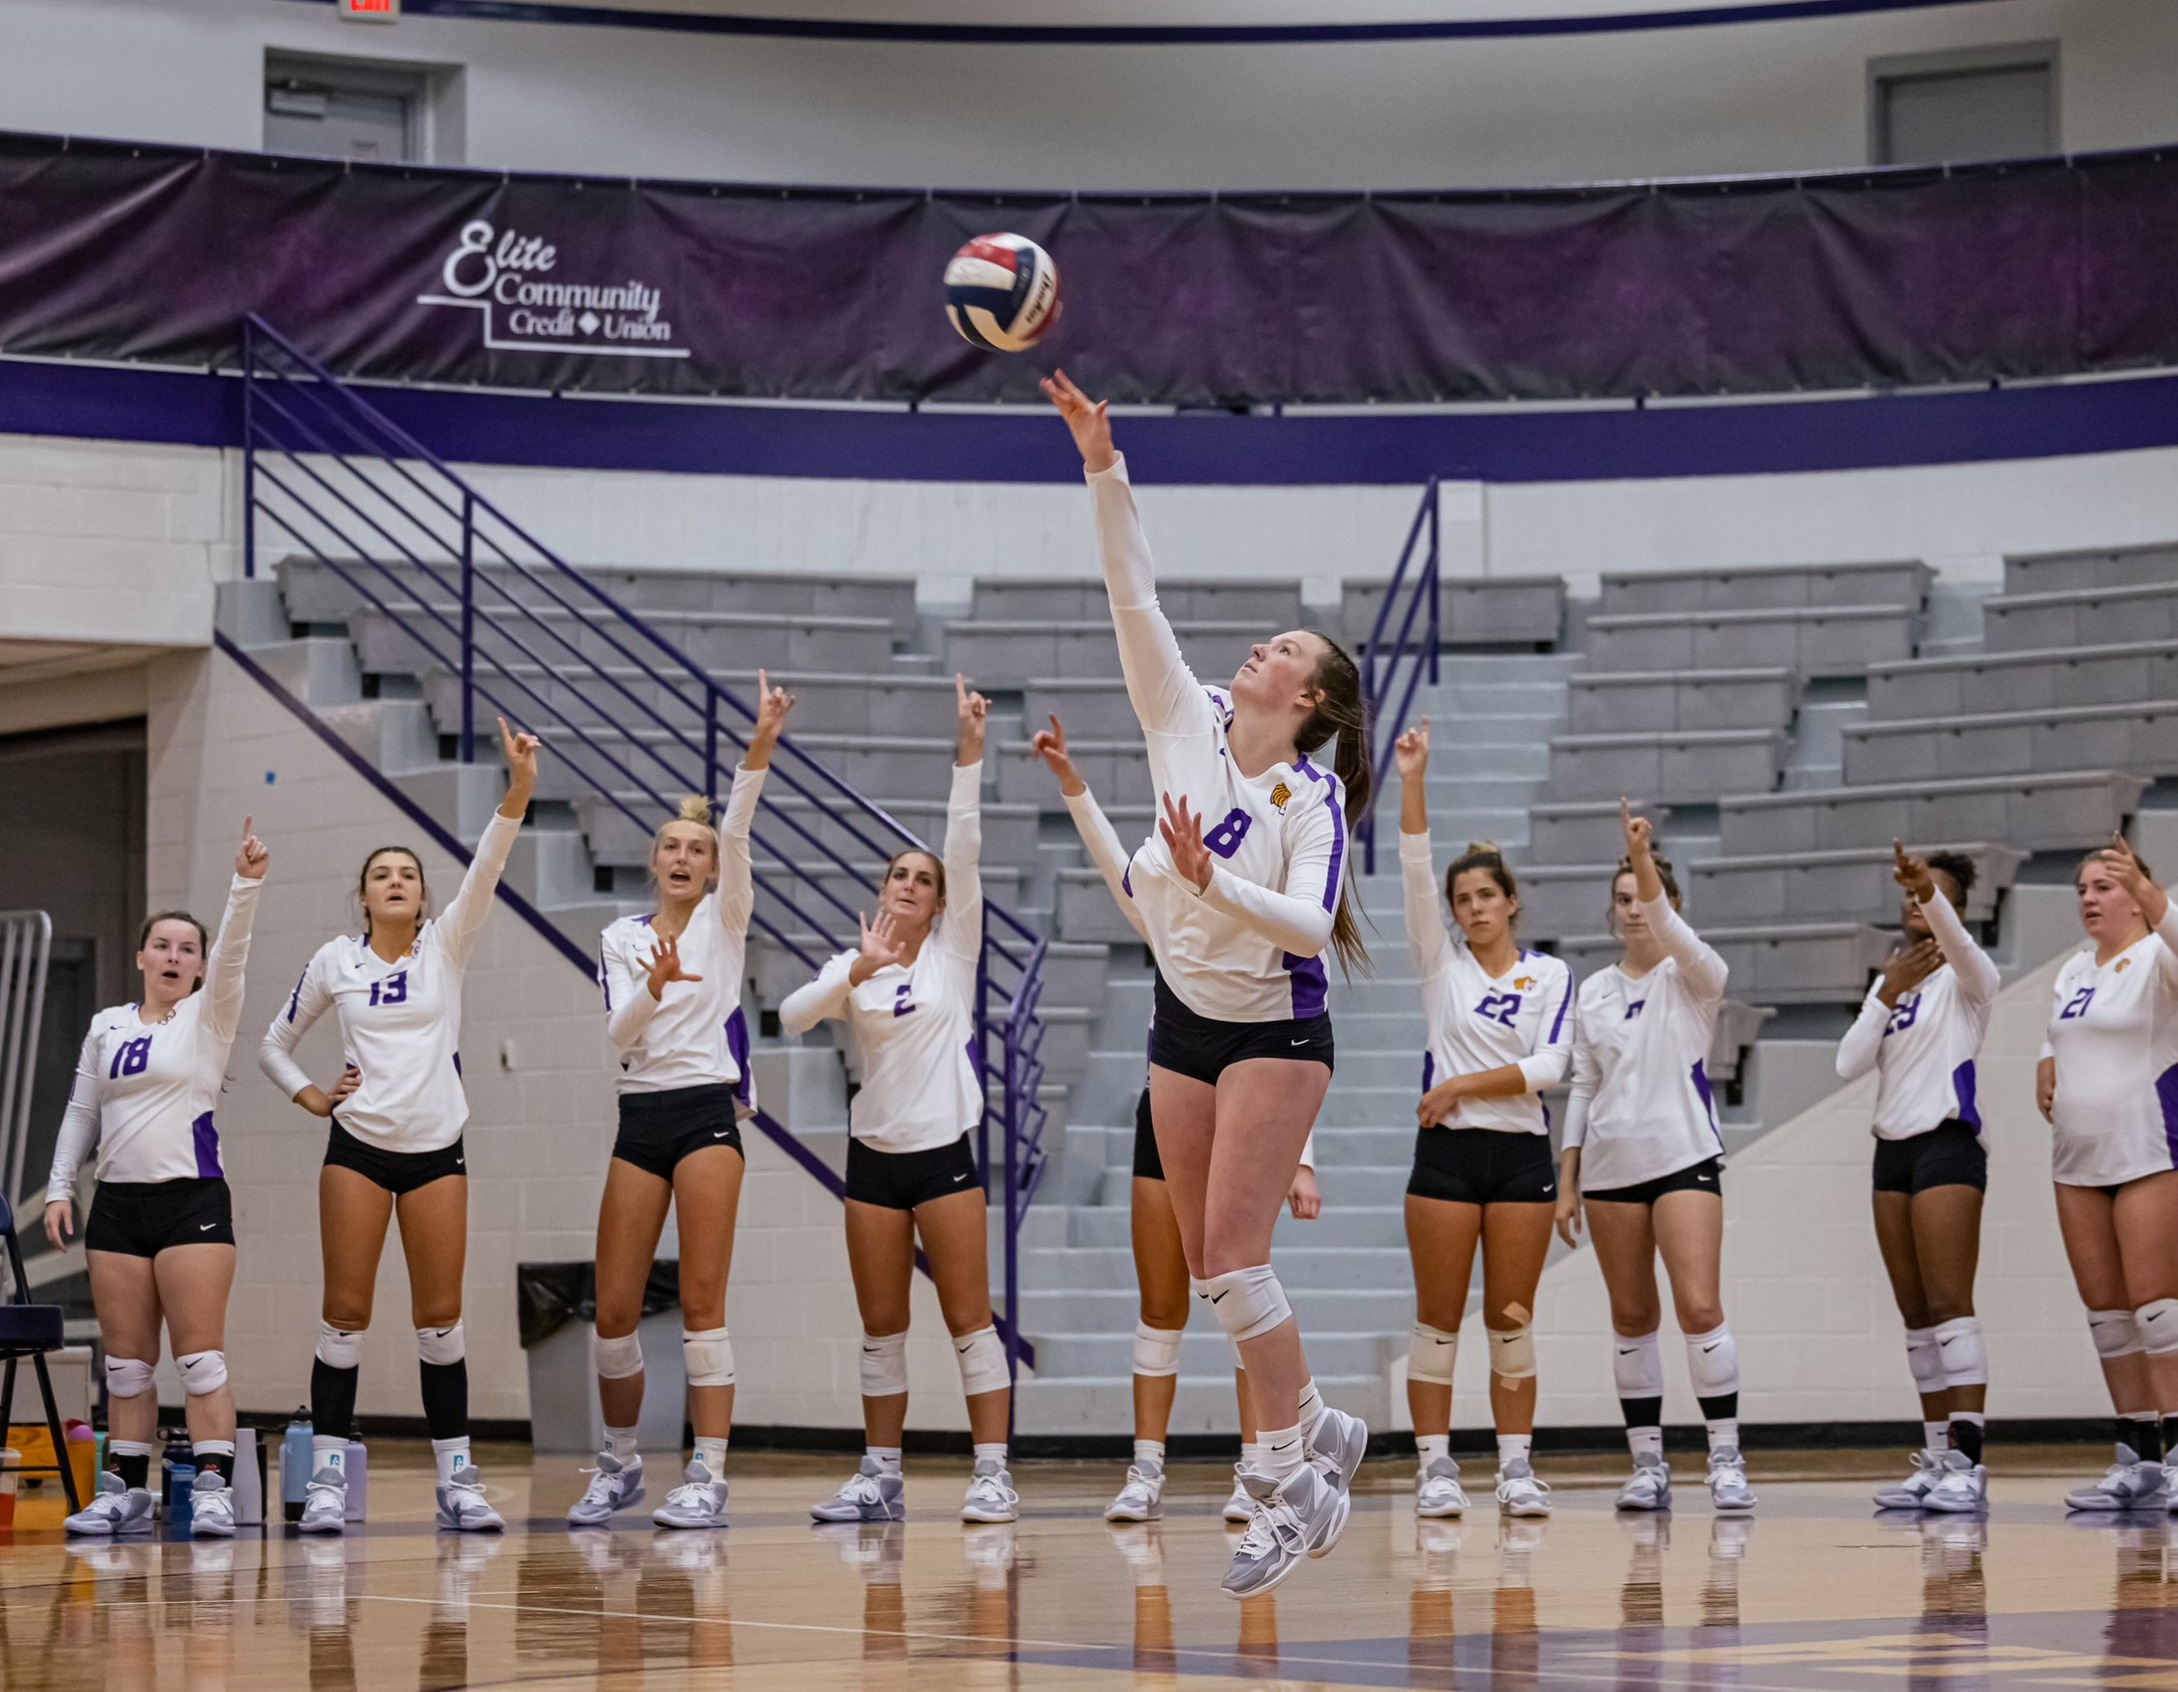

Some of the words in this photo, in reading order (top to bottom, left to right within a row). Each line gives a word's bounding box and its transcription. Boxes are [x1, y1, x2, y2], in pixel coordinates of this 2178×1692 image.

[443, 219, 557, 297] Elite
[494, 272, 661, 323] Community
[509, 308, 575, 336] Credit
[603, 314, 672, 341] Union
[1203, 807, 1252, 859] 8
[369, 970, 408, 1006] 13
[893, 984, 916, 1018] 2
[2060, 987, 2095, 1019] 21
[1473, 993, 1522, 1029] 22
[109, 1033, 153, 1079] 18
